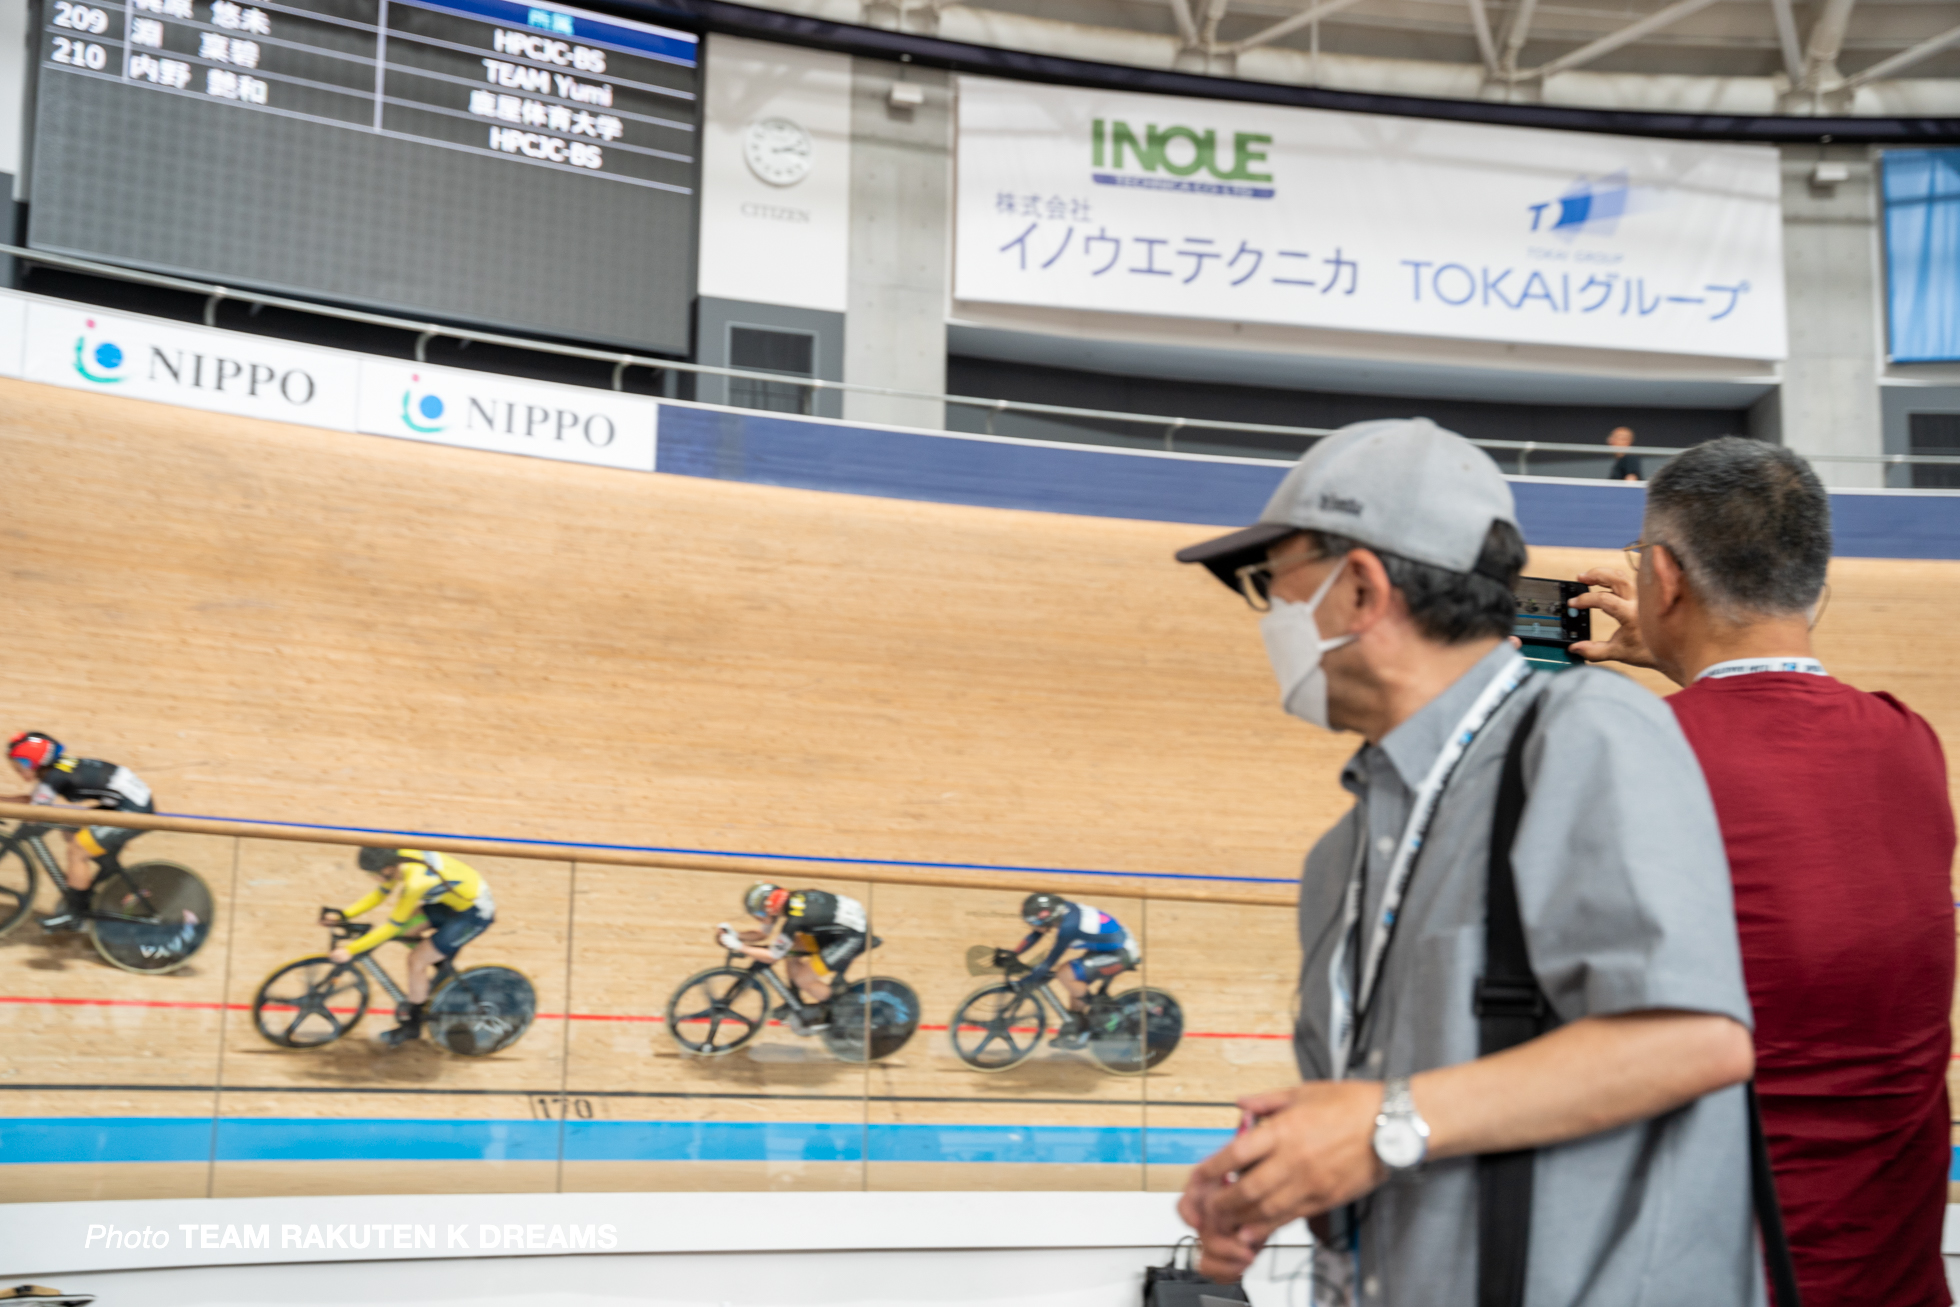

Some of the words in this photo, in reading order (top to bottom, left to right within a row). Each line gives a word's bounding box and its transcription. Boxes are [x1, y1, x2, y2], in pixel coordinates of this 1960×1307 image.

[53, 0, 108, 34] 209
[51, 37, 106, 69] 210
[129, 53, 192, 89] 内野
[482, 58, 551, 94] TEAM
[553, 73, 613, 107] Yumi
[1091, 118, 1274, 183] INOUE
[740, 201, 810, 224] CITIZEN
[996, 192, 1093, 221] 株式会社
[999, 222, 1358, 296] イノウエテクニカ
[1400, 259, 1751, 321] TOKAIグループ
[148, 344, 316, 405] NIPPO
[466, 396, 616, 448] NIPPO
[538, 1098, 594, 1119] 170
